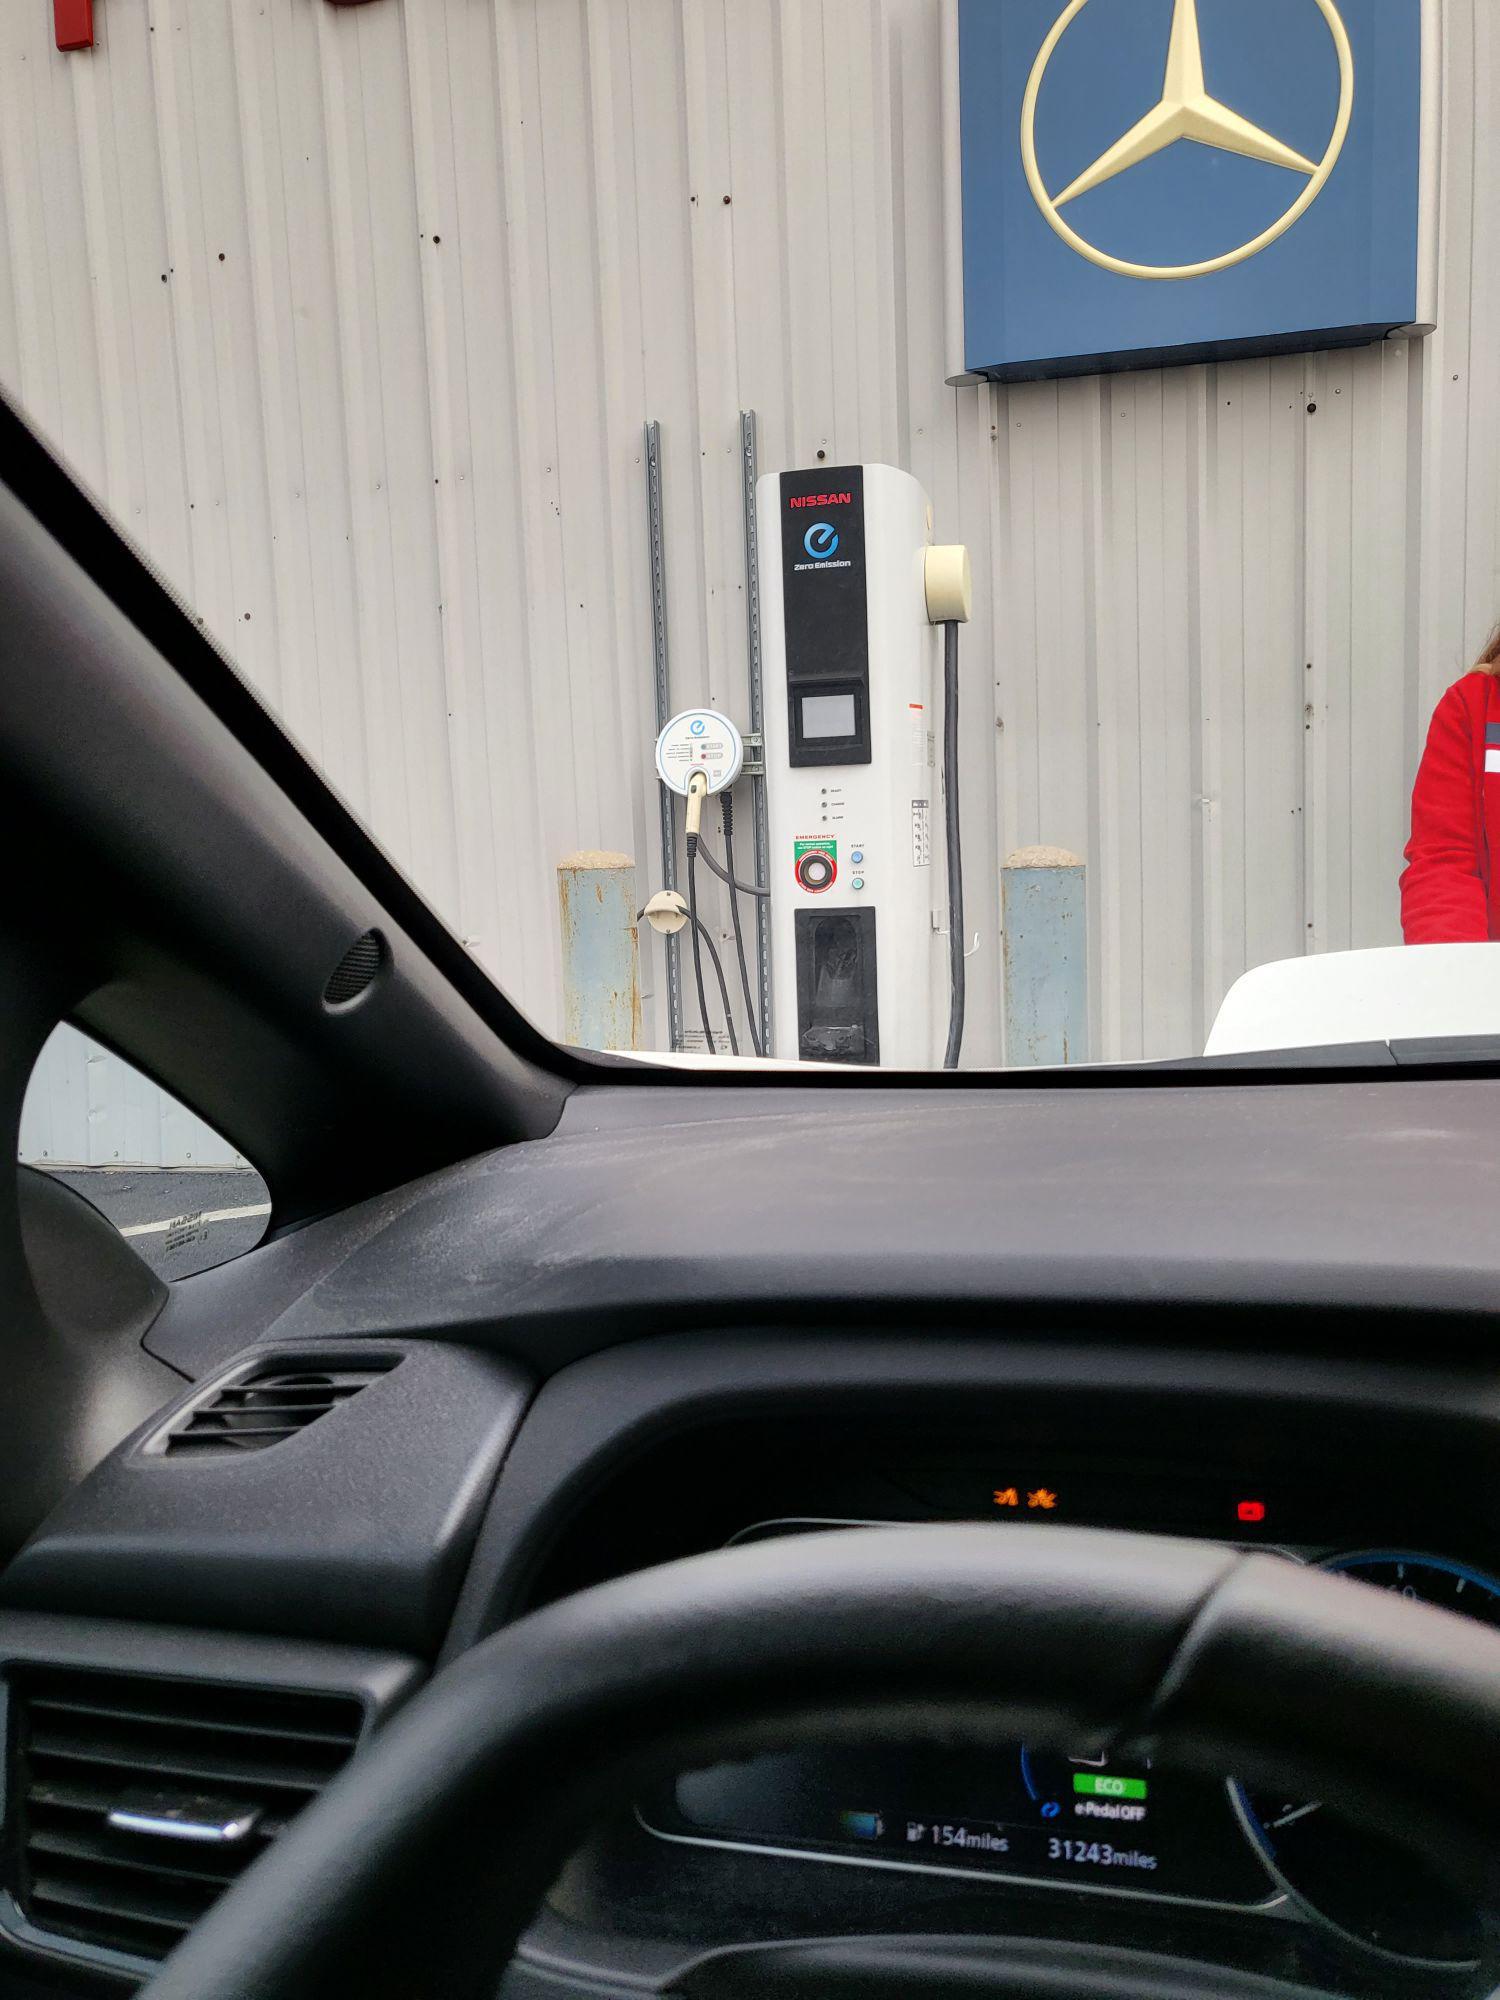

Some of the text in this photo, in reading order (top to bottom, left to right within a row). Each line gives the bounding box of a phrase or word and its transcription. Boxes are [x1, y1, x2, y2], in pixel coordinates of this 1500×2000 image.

[790, 492, 852, 509] NISSAN
[794, 560, 852, 571] Zero Emission
[1095, 1776, 1124, 1796] ECO
